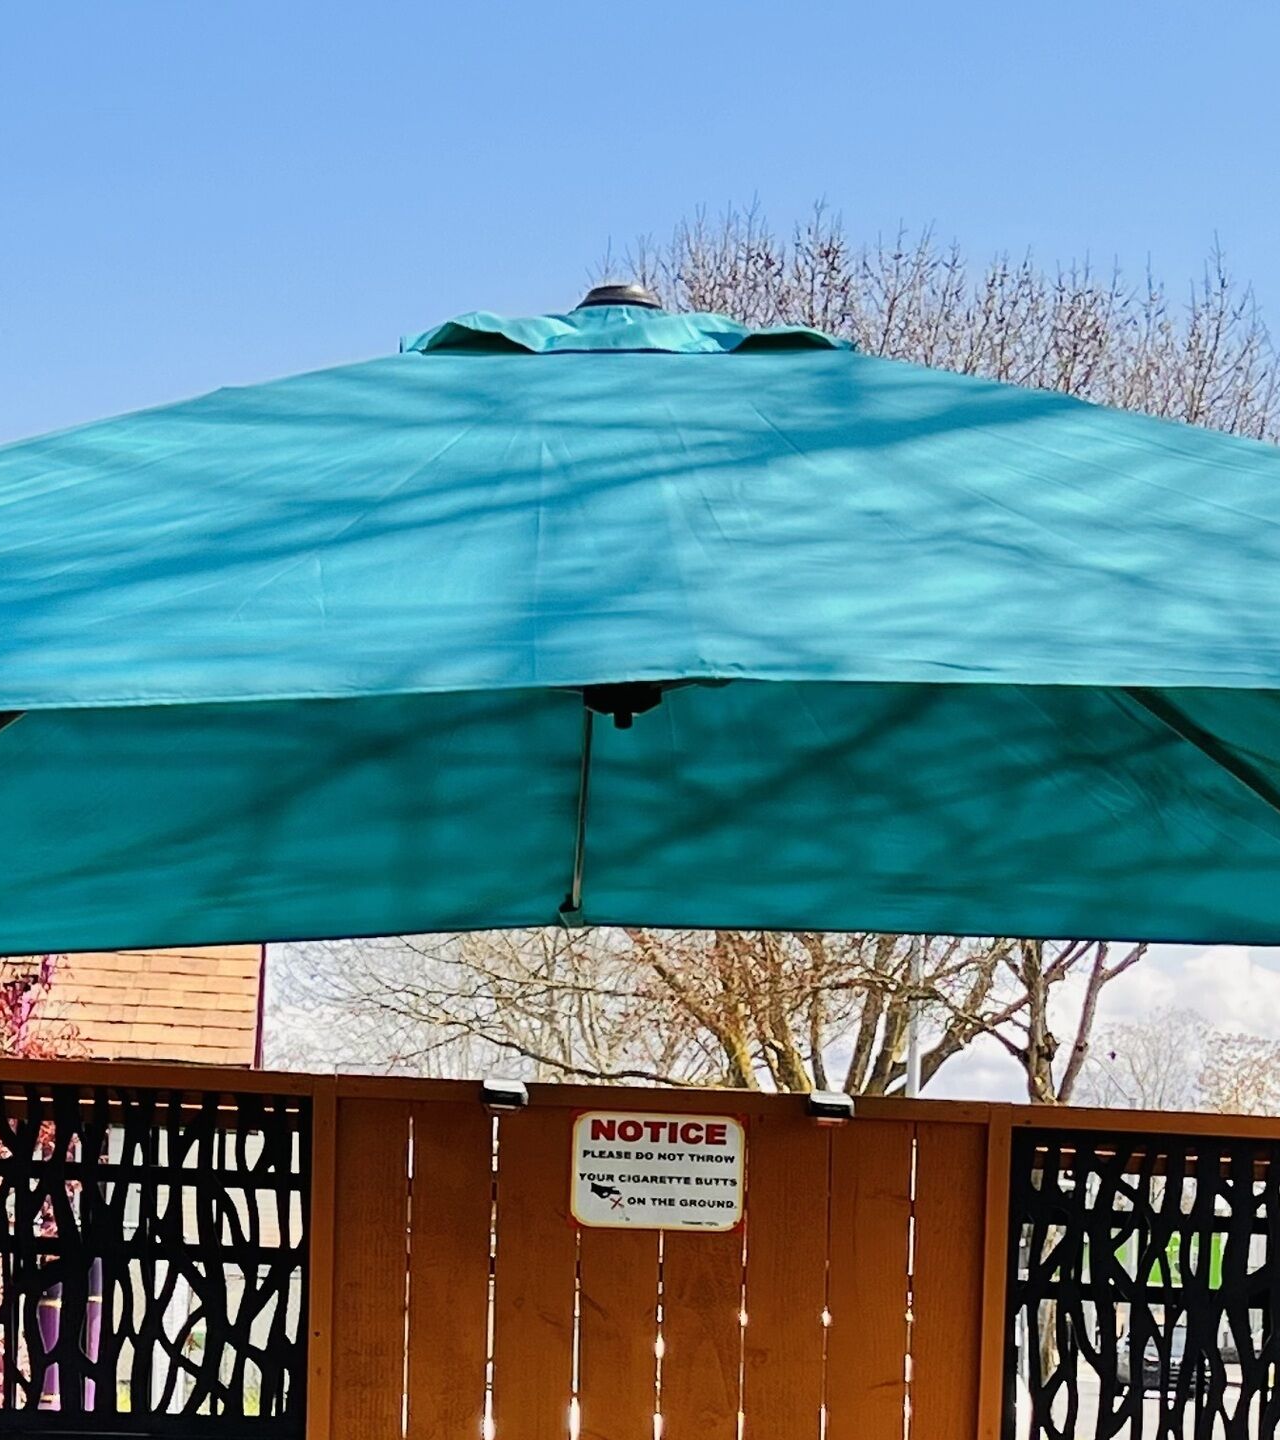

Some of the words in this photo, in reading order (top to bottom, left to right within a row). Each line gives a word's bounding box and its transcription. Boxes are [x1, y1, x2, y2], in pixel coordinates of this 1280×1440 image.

[591, 1119, 727, 1146] NOTICE
[582, 1150, 632, 1160] PLEASE
[635, 1151, 654, 1160] DO
[658, 1152, 685, 1162] NOT
[689, 1153, 735, 1164] THROW
[579, 1173, 615, 1183] YOUR
[618, 1174, 691, 1185] CIGARETTE
[695, 1177, 738, 1187] BUTTS
[627, 1197, 646, 1206] ON
[651, 1197, 676, 1207] THE
